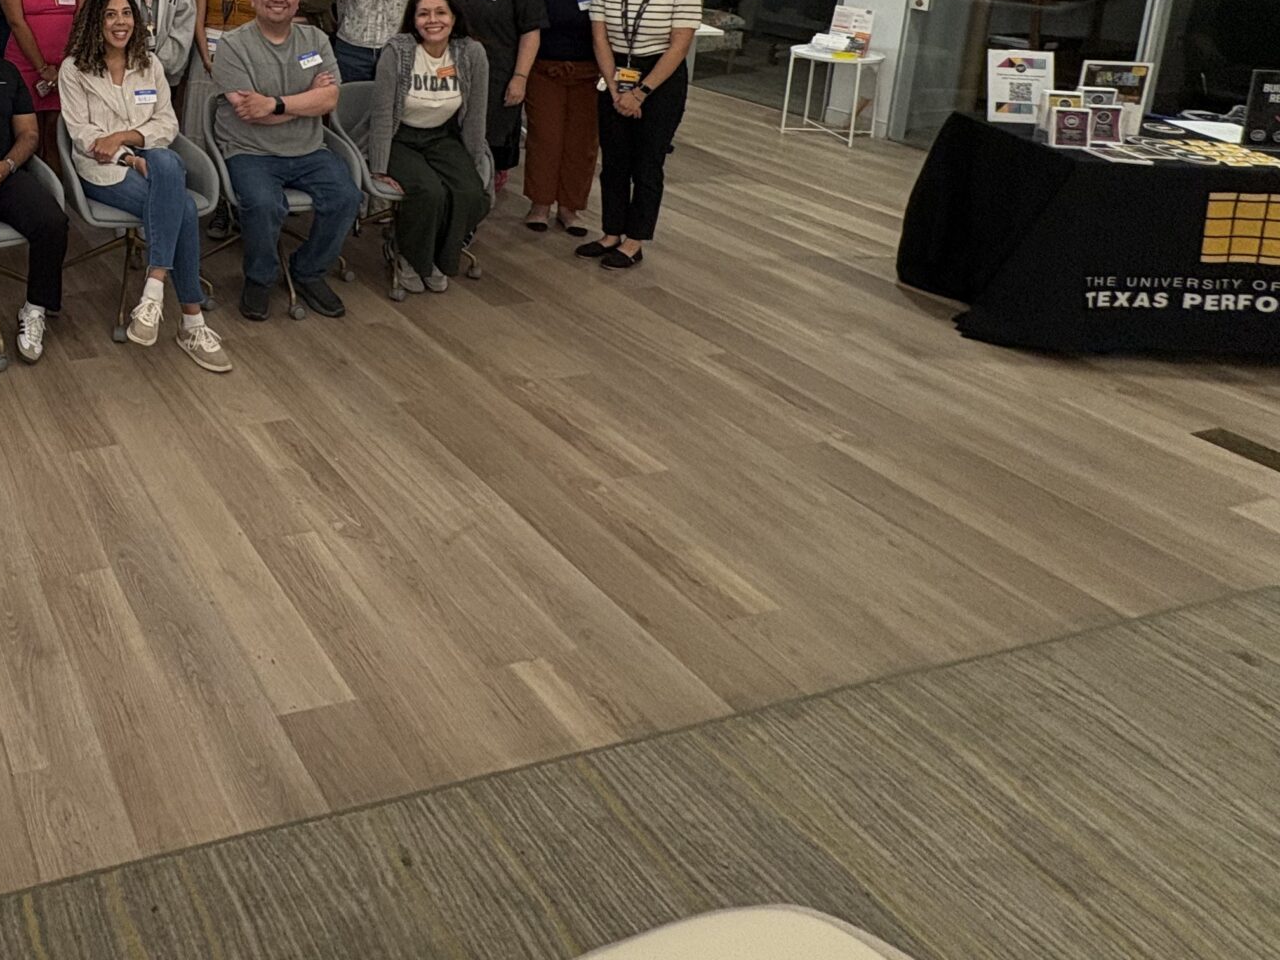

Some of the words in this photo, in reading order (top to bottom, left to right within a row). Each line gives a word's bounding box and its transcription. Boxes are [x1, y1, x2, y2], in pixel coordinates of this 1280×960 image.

[1085, 276, 1117, 288] THE
[1126, 276, 1243, 290] UNIVERSITY
[1252, 279, 1280, 291] OF
[1085, 291, 1169, 309] TEXAS
